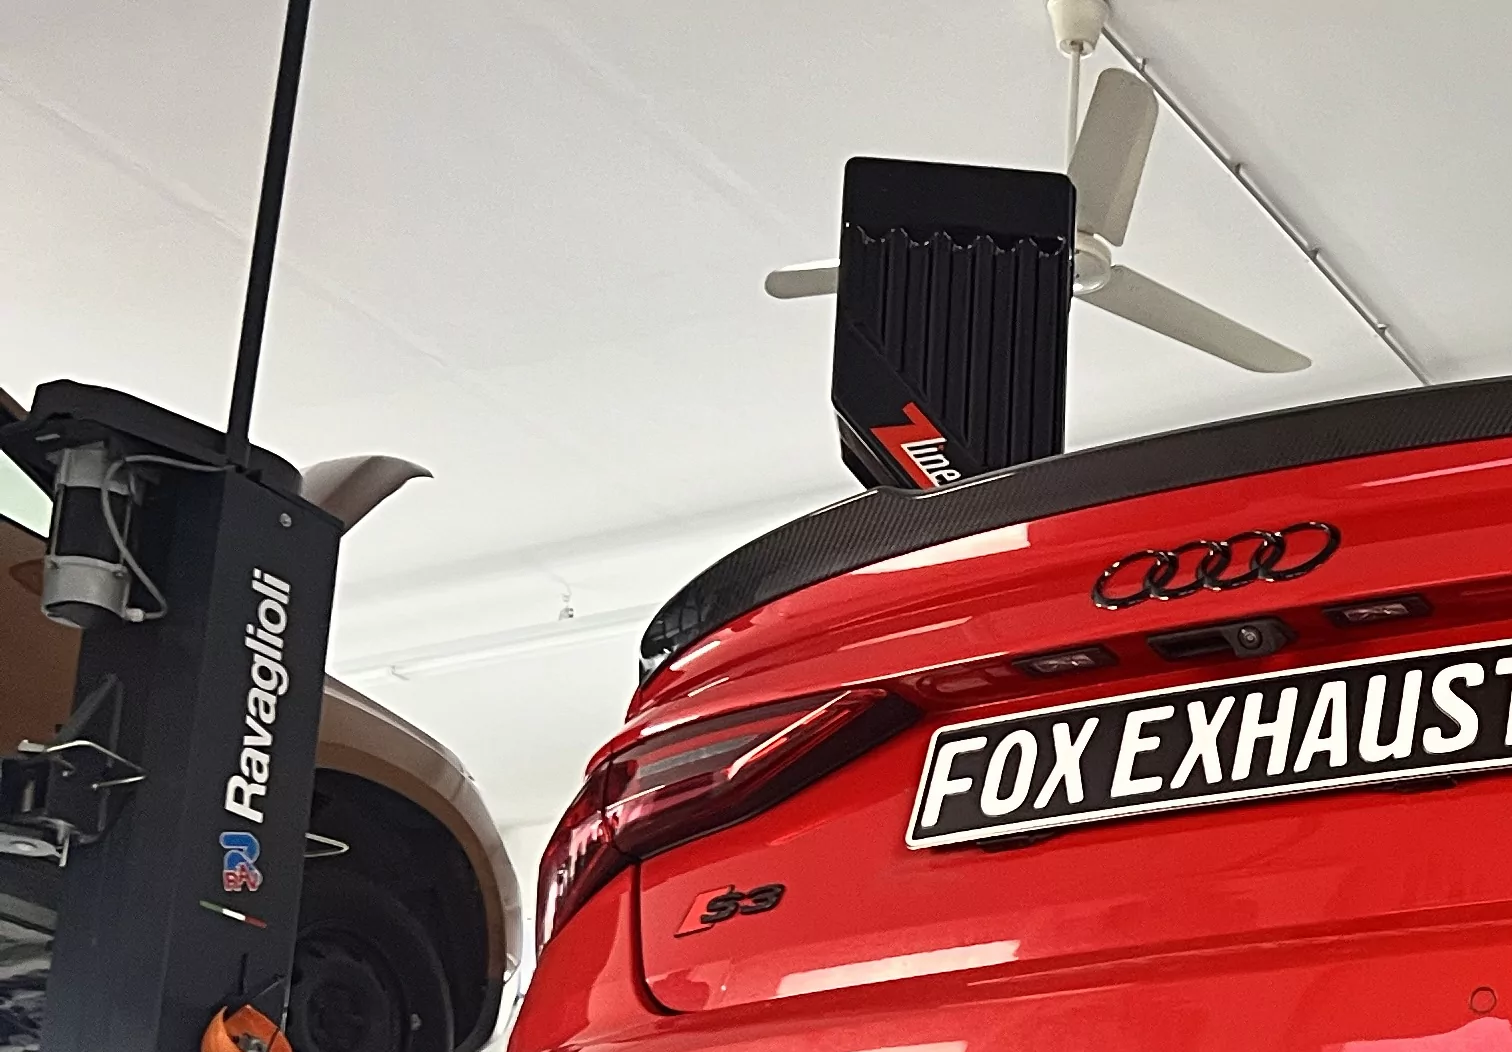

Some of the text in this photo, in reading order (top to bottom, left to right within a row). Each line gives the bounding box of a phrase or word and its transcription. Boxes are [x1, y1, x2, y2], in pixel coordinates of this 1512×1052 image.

[223, 567, 292, 824] Ravaglioli
[920, 716, 1100, 829] FOX
[700, 883, 786, 924] S3
